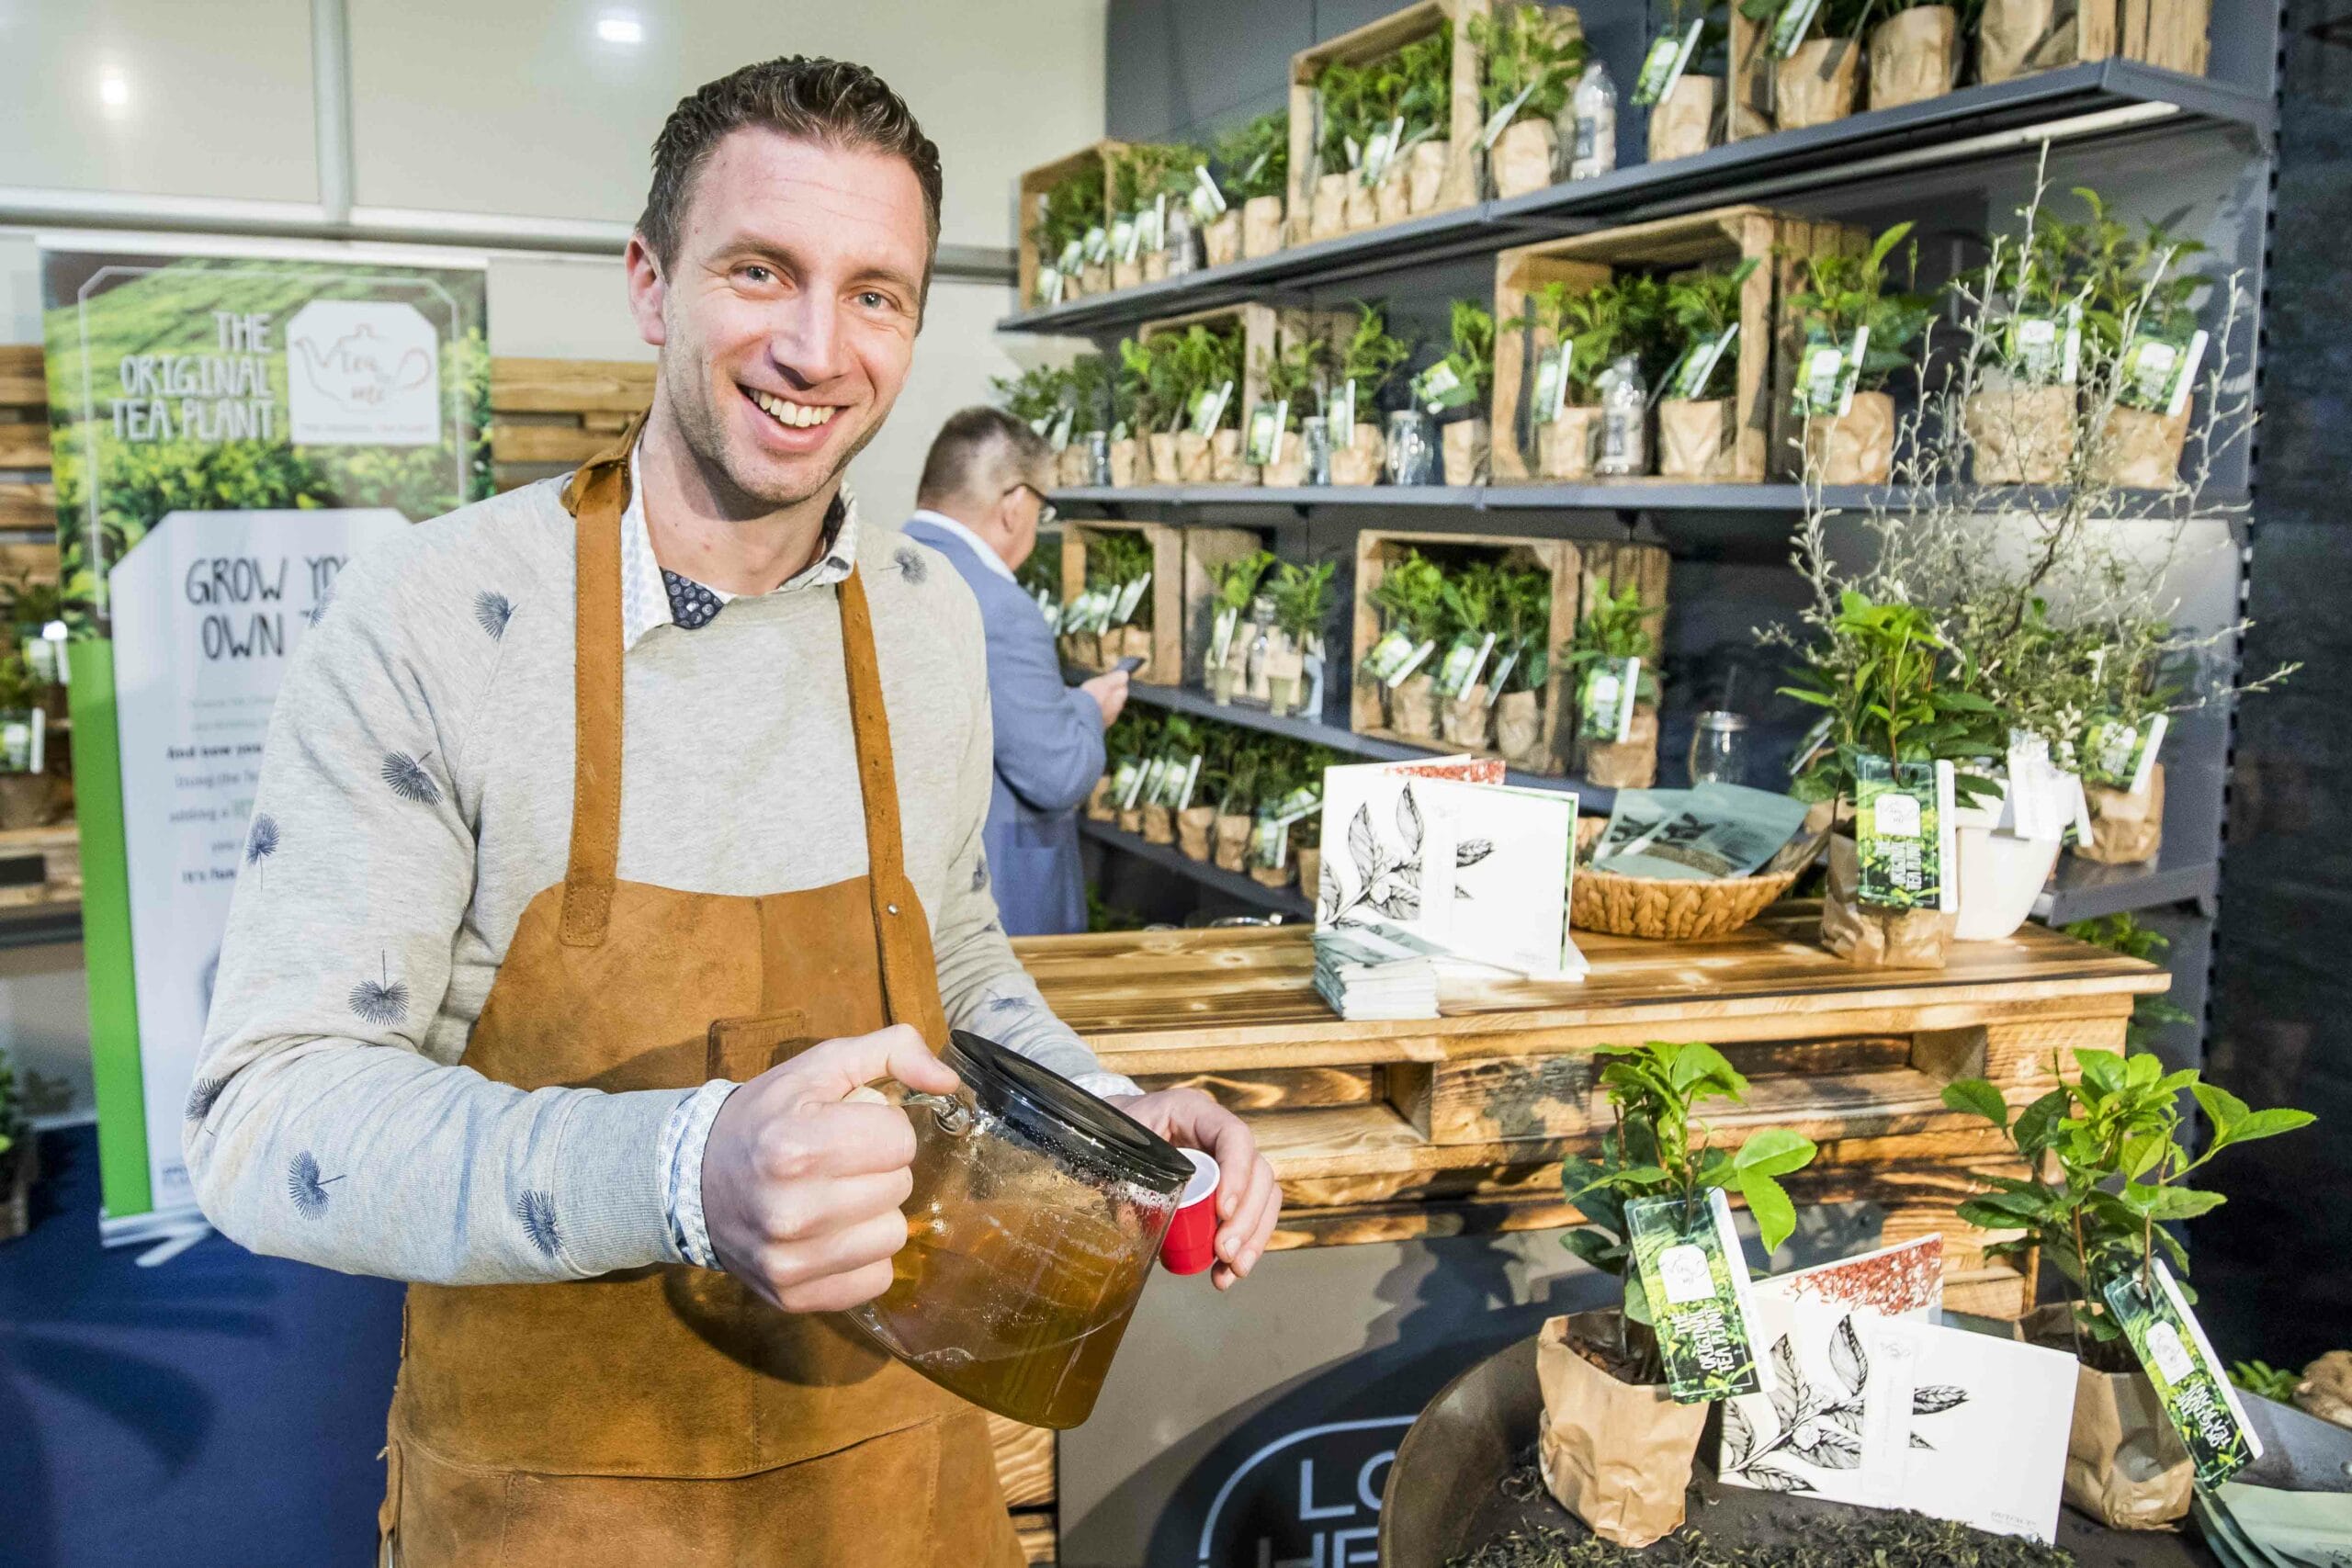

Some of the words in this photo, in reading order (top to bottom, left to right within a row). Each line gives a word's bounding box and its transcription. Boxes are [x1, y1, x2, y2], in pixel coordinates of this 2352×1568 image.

[212, 310, 273, 353] THE
[119, 354, 275, 398] ORIGINAL
[110, 397, 175, 440] TEA
[182, 399, 275, 440] PLANT
[185, 556, 288, 605] GROW
[202, 613, 284, 660] OWN
[1669, 1311, 1688, 1336] THE
[1687, 1309, 1717, 1371] ORIGINAL
[1705, 1307, 1730, 1347] PLANT
[1714, 1345, 1736, 1373] TEA
[2182, 1387, 2218, 1448] ORIGINAL
[2209, 1417, 2233, 1447] TEA
